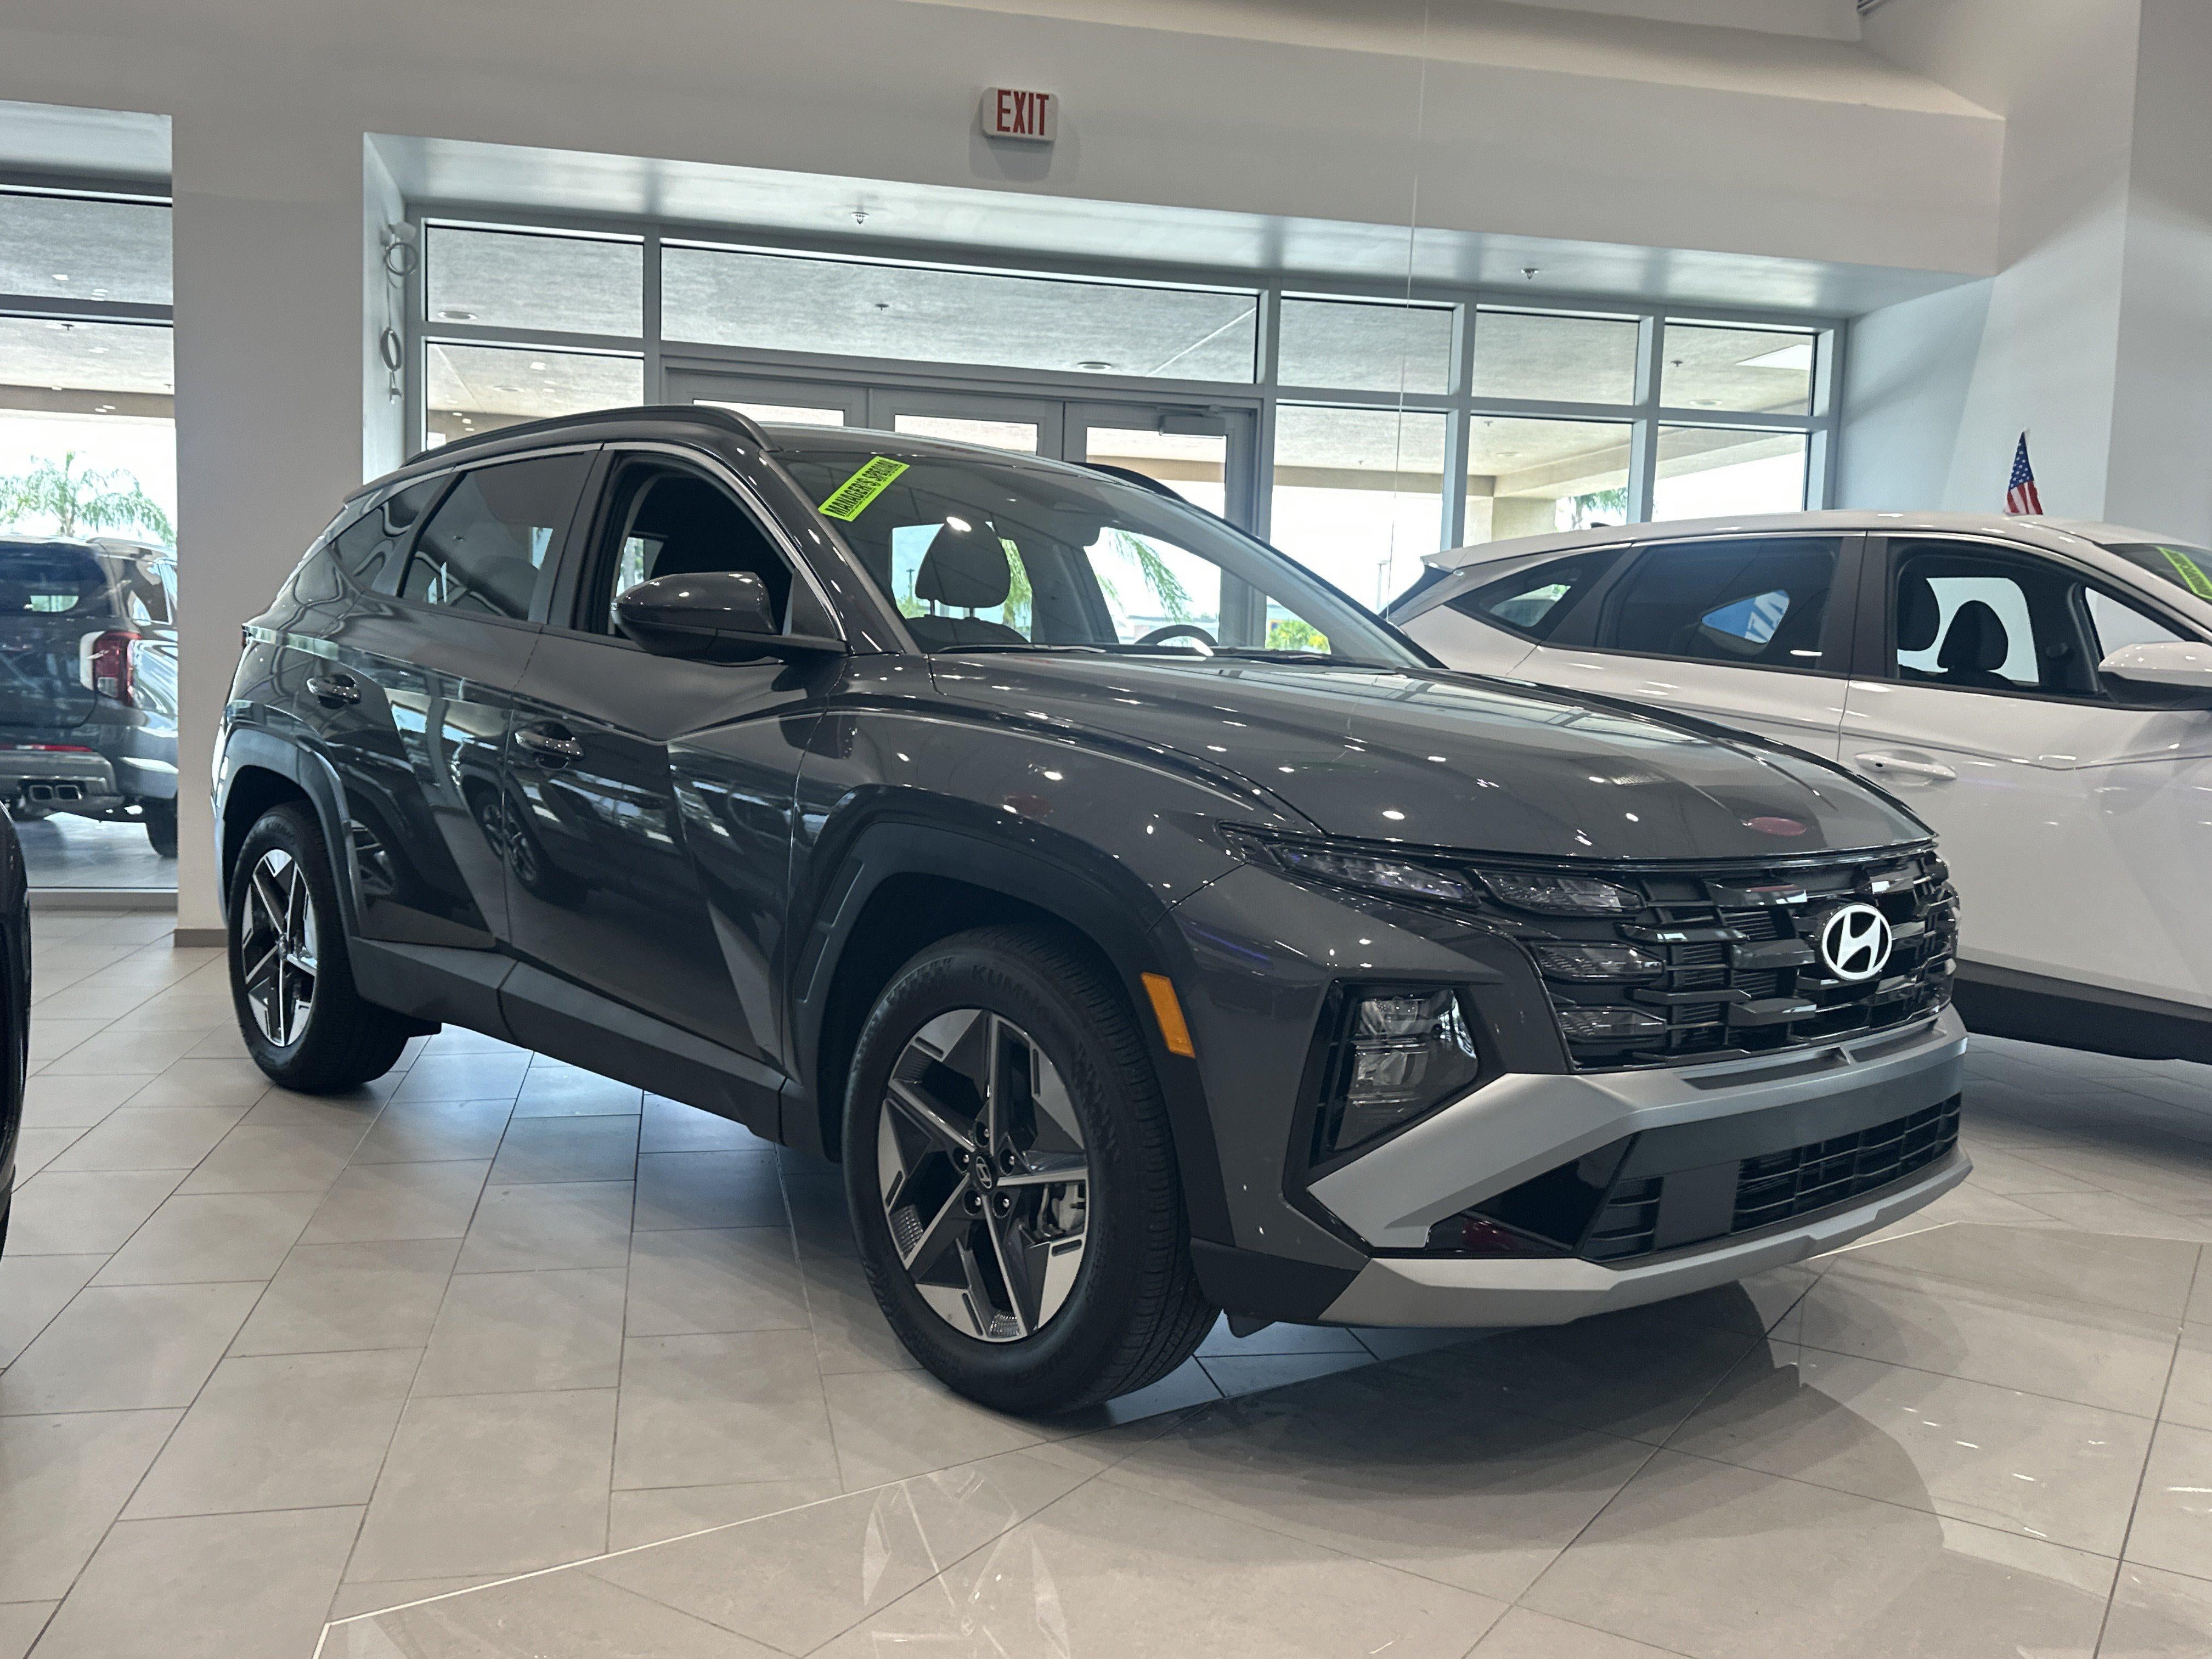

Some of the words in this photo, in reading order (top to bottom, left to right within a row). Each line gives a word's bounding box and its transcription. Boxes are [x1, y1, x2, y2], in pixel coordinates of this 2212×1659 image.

[997, 89, 1049, 136] EXIT
[823, 477, 879, 517] MANAGER'S
[861, 459, 899, 482] SPECIAL
